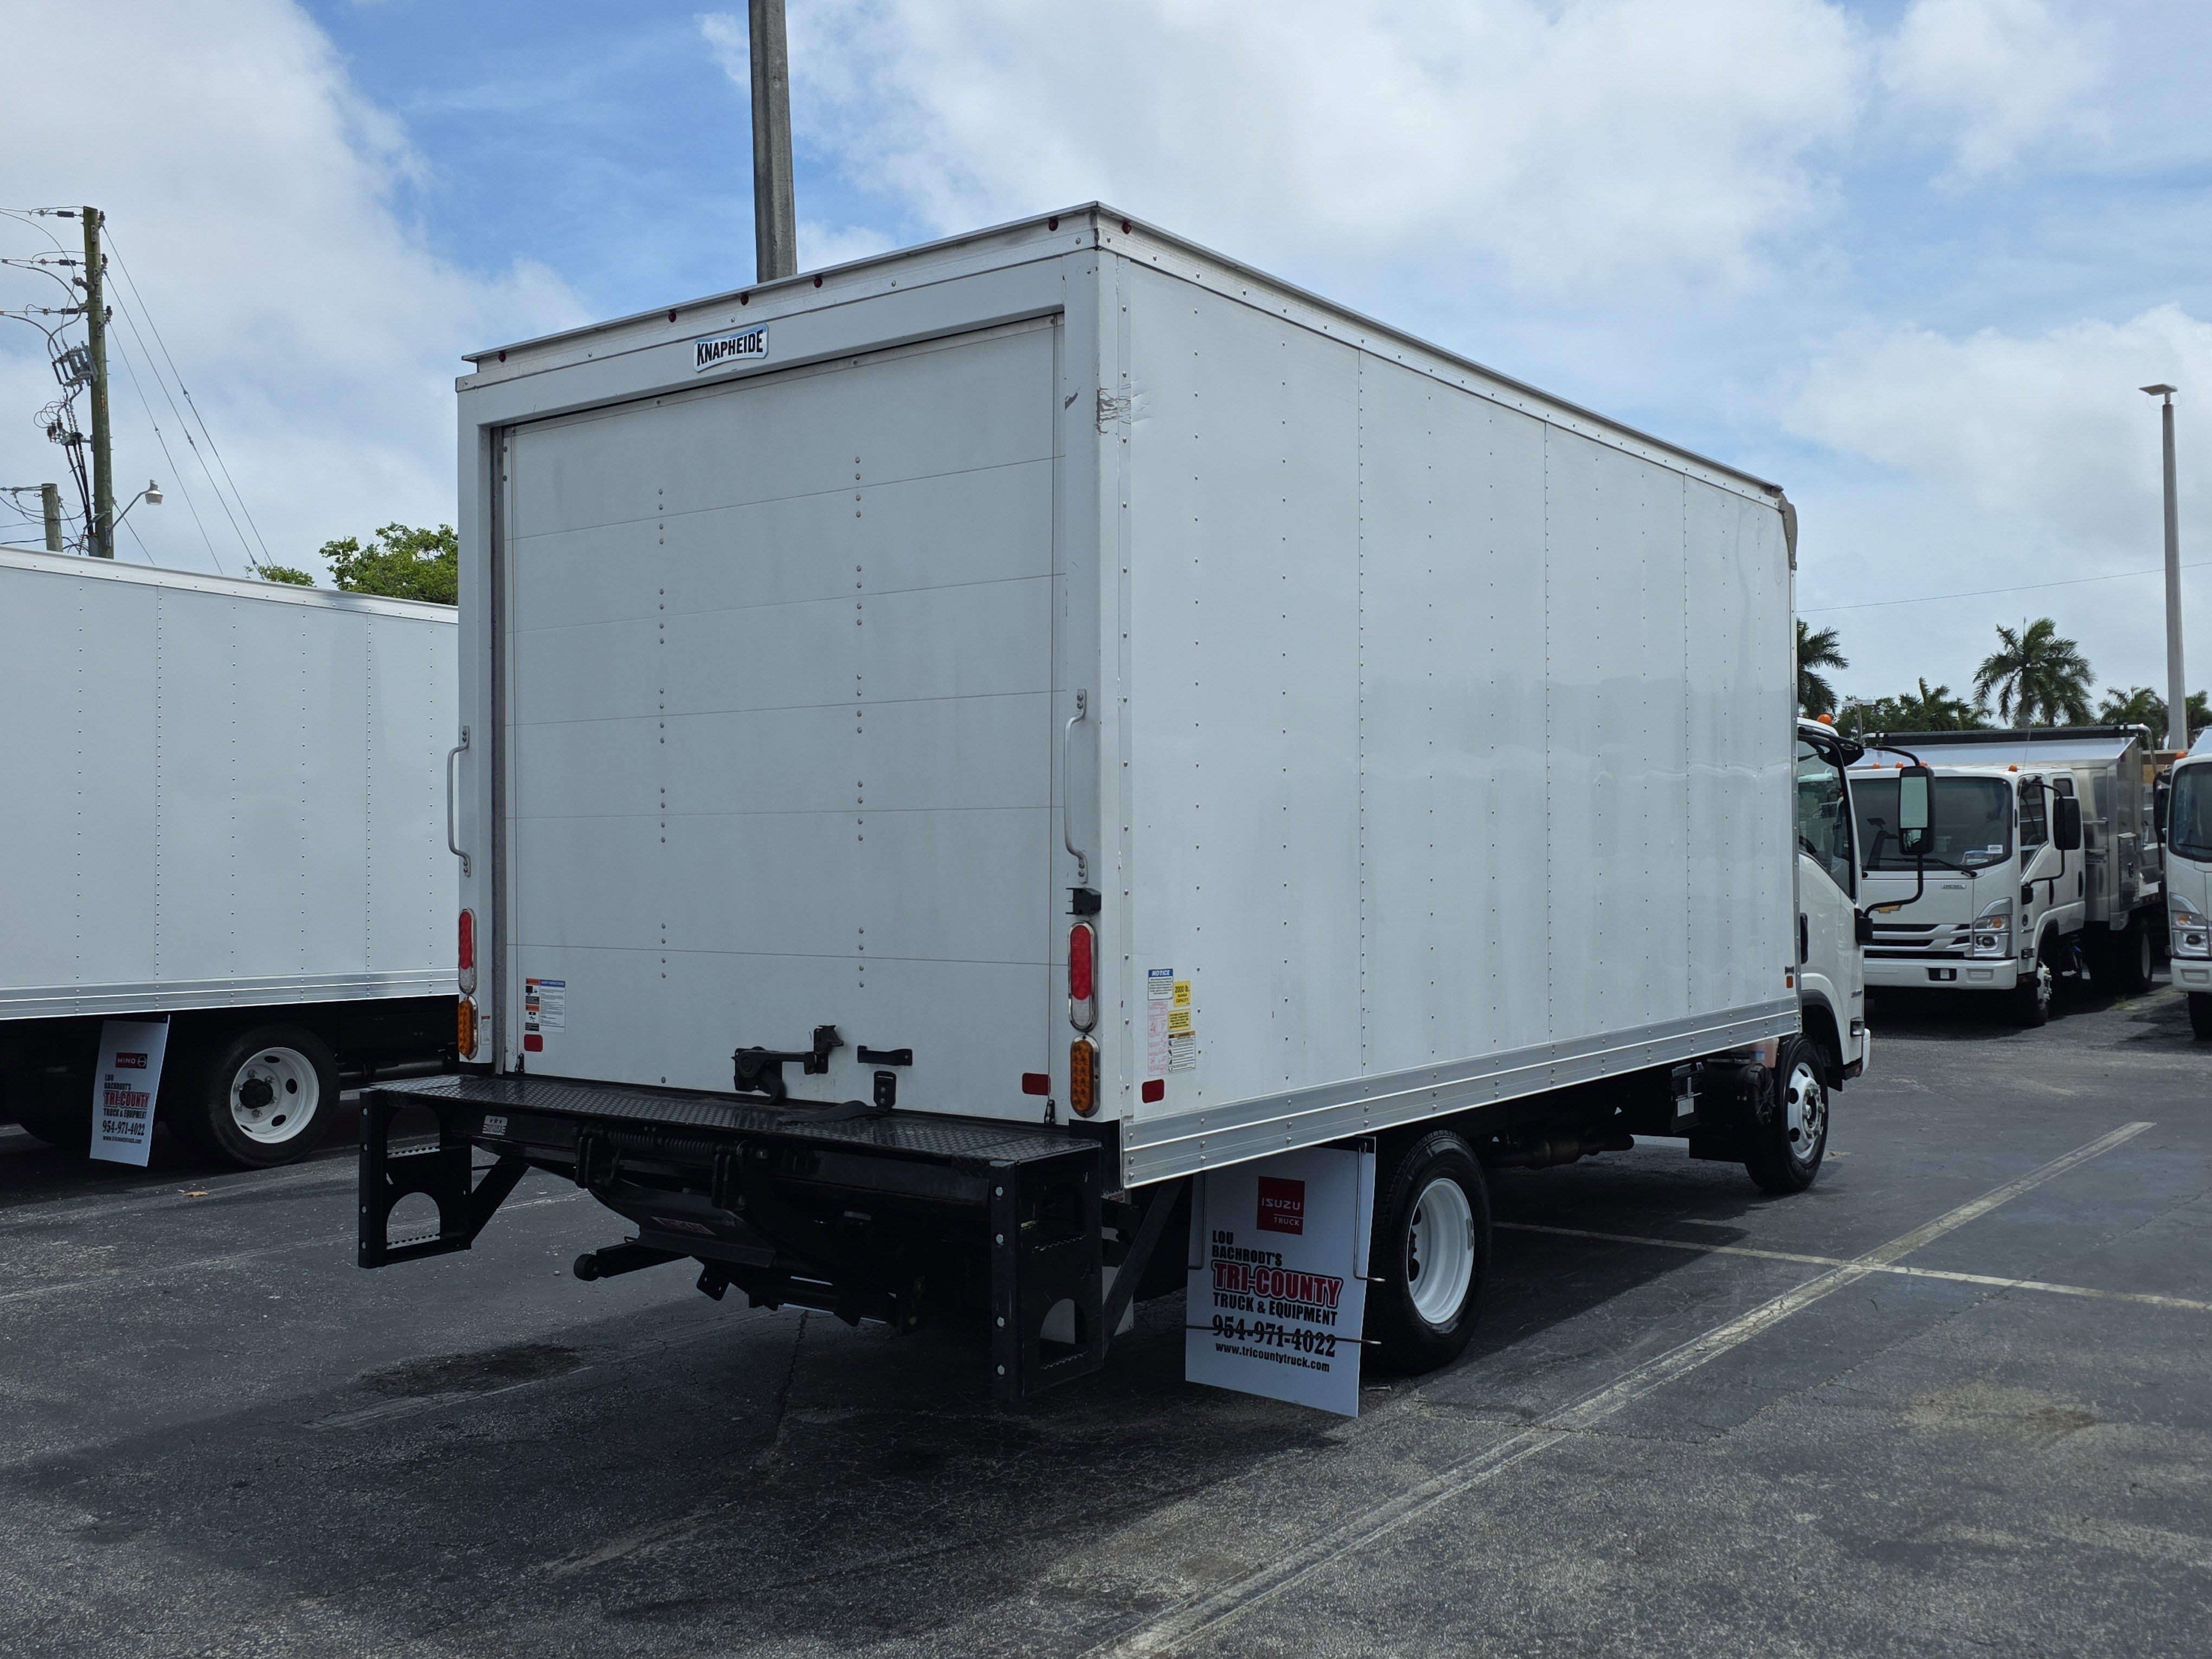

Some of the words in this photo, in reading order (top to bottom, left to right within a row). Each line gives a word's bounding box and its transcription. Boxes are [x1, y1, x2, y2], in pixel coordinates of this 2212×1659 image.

[697, 329, 763, 367] KNAPHEIDE
[104, 1091, 150, 1109] TRI-COUNTY
[104, 1108, 119, 1117] TRUCK
[124, 1110, 147, 1120] EQUIPMENT
[102, 1121, 145, 1136] 954-971-4022
[1262, 1197, 1301, 1211] ISUZU
[1273, 1217, 1301, 1227] TRUCK
[1212, 1230, 1234, 1245] LOU
[1212, 1245, 1282, 1267] BACHRODT'S
[1212, 1261, 1342, 1308] TRI-COUNTY
[1213, 1292, 1254, 1313] TRUCK
[1257, 1300, 1266, 1314] &
[1269, 1300, 1338, 1327] EQUIPMENT
[1212, 1315, 1336, 1358] 954-971-4022
[1216, 1343, 1330, 1373] www.tricountytruck.com
